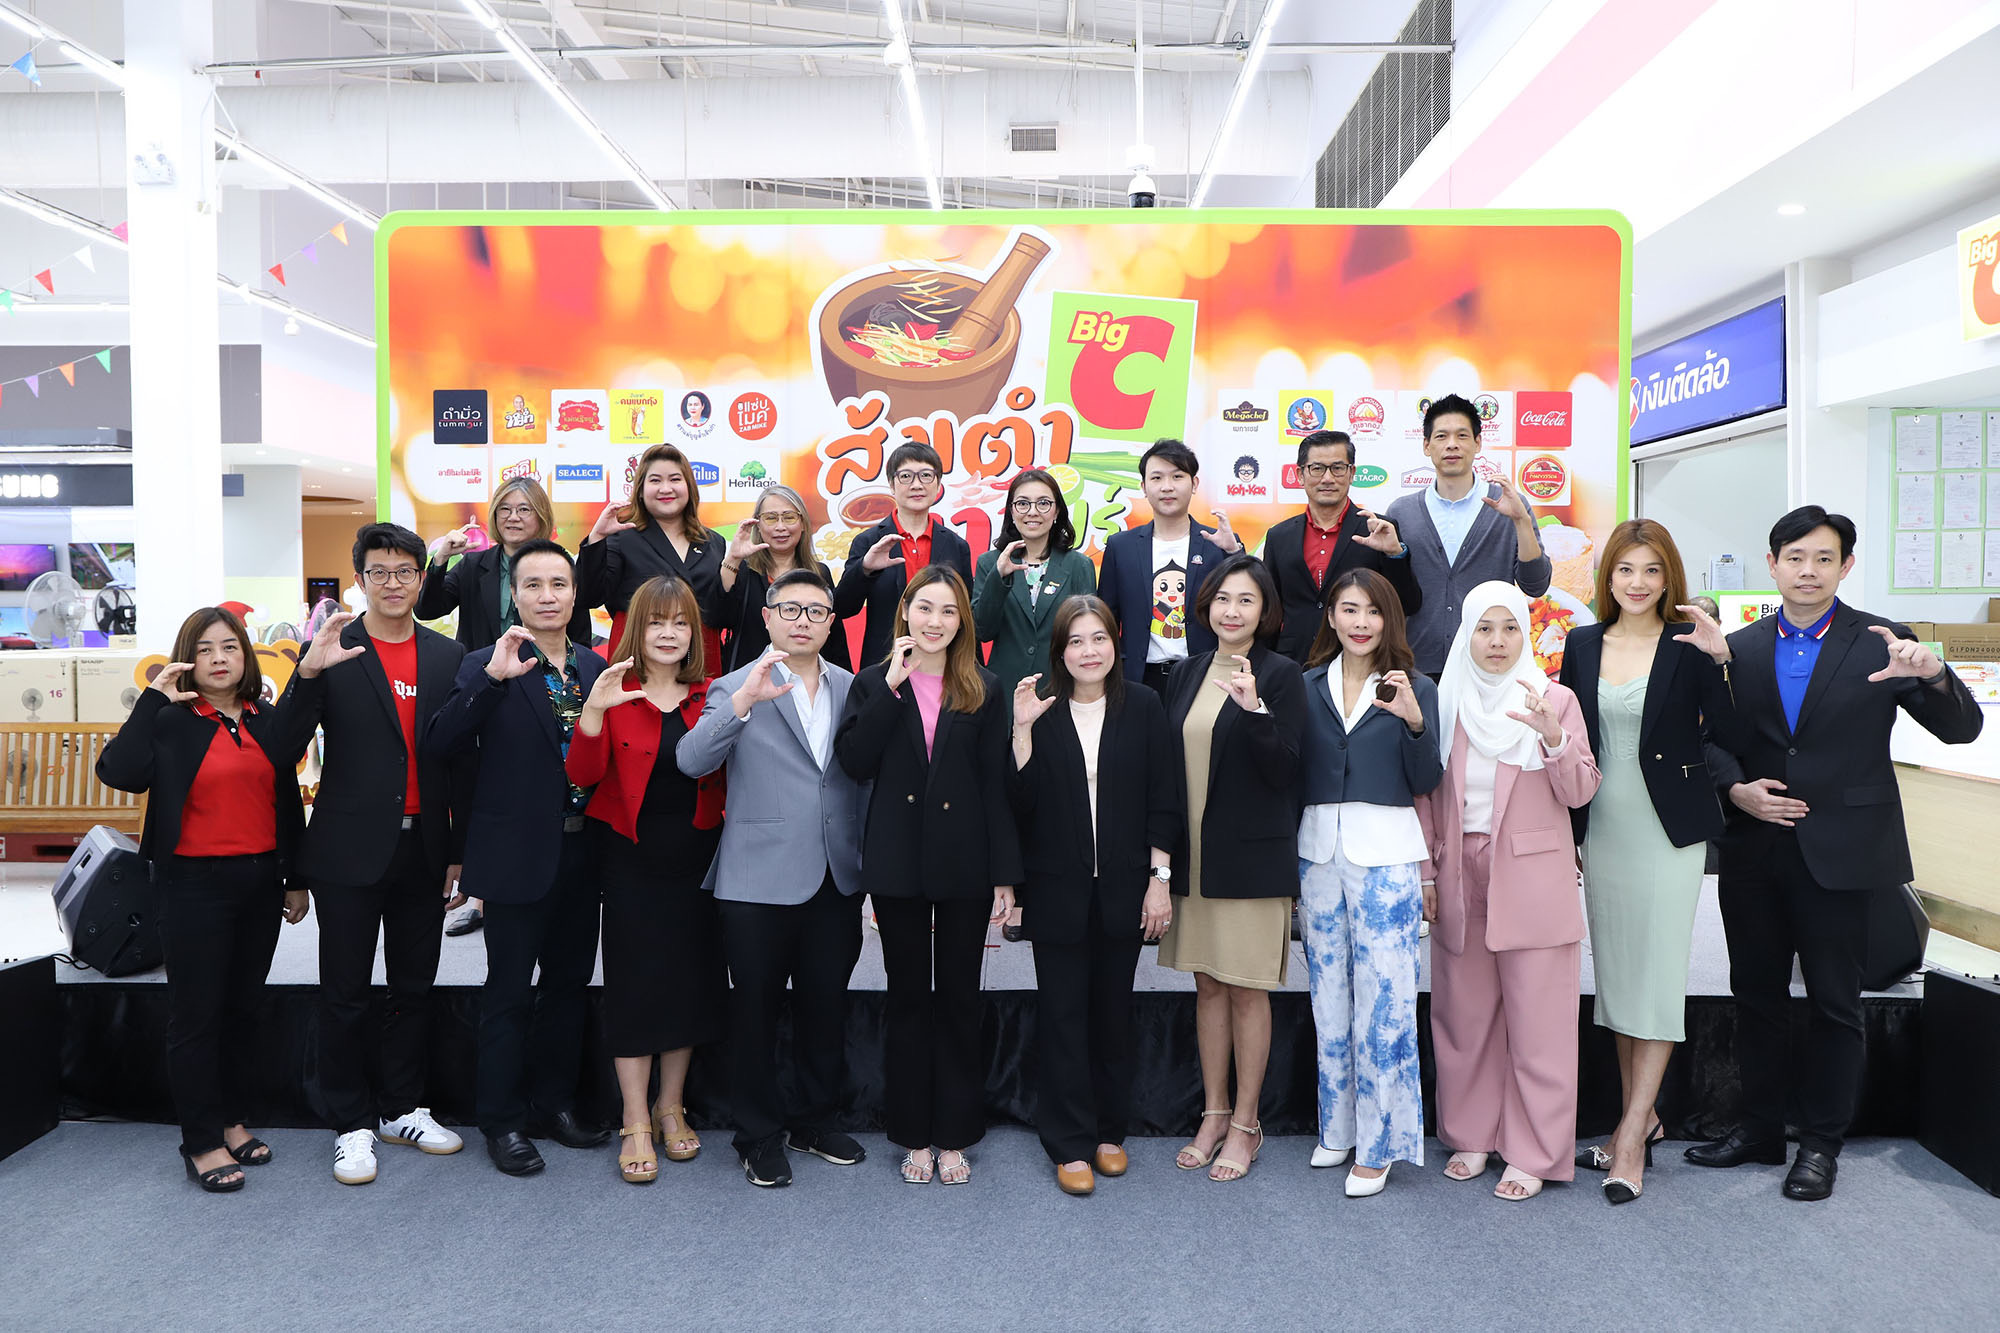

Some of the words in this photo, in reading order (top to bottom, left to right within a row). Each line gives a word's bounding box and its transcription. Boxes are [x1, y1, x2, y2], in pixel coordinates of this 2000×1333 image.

[1971, 235, 1998, 266] Big
[1071, 313, 1129, 351] Big
[1070, 315, 1175, 430] C
[1641, 350, 1730, 414] เงินติดล้อ
[620, 397, 658, 406] คนแบกกุ้ง
[744, 397, 768, 412] แซ่บ
[443, 405, 481, 420] ตำมั่ว
[1224, 410, 1267, 421] Megachef
[1520, 410, 1568, 427] Coca-Cola
[438, 421, 483, 429] tummour
[739, 425, 751, 433] ZAB
[752, 422, 767, 430] MIKE
[825, 386, 1075, 495] ส้มตำ
[558, 469, 600, 477] SEALECT
[694, 466, 717, 480] tilus
[1353, 474, 1385, 482] ETAGRO
[0, 474, 59, 498] UNG
[729, 476, 777, 488] Heritage
[1227, 484, 1267, 496] Koh-Kae
